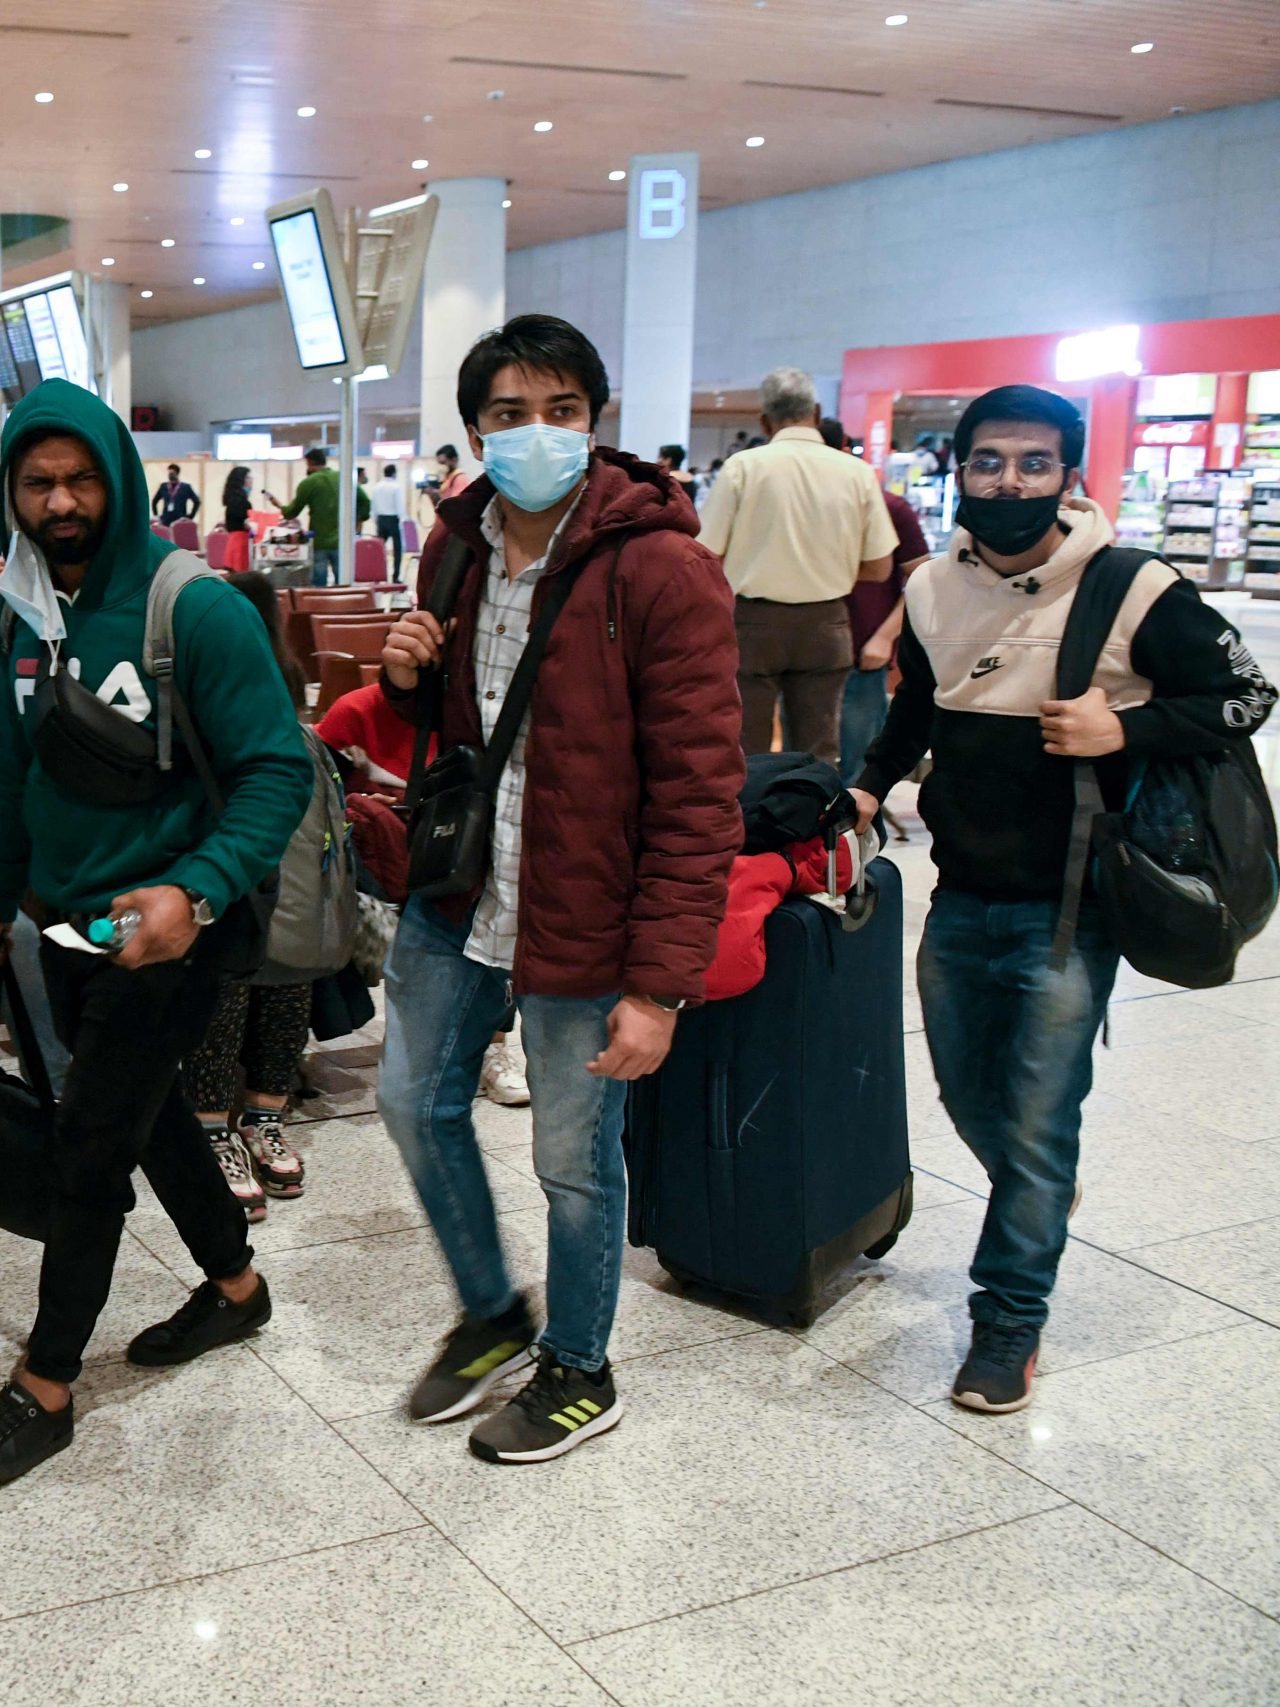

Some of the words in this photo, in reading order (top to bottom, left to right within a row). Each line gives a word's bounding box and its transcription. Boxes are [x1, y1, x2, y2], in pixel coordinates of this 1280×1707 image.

[640, 170, 686, 239] B
[976, 656, 1000, 668] NIKE
[15, 657, 152, 723] FA
[433, 822, 455, 838] FILA
